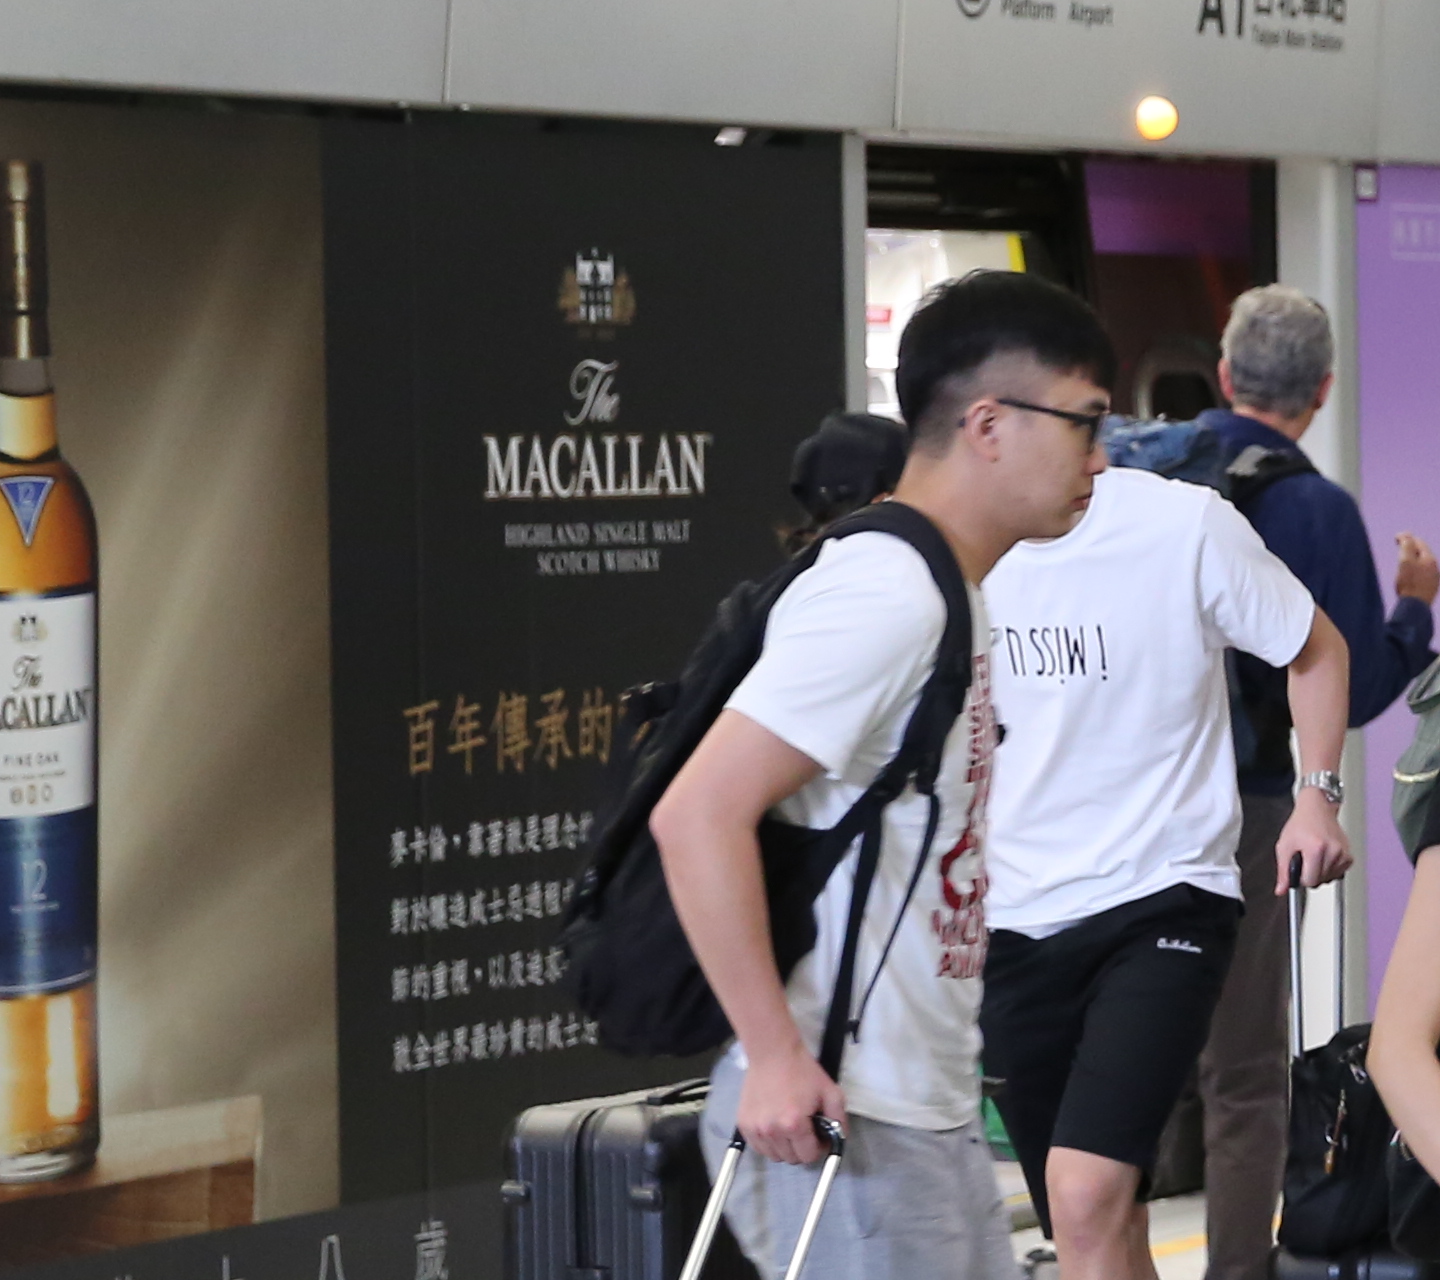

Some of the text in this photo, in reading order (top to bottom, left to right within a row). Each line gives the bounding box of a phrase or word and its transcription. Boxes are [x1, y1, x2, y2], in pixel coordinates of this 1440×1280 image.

[564, 358, 621, 426] The
[483, 432, 712, 500] MACALLAN
[403, 683, 652, 776] 百年傳承的
[21, 857, 49, 901] 12
